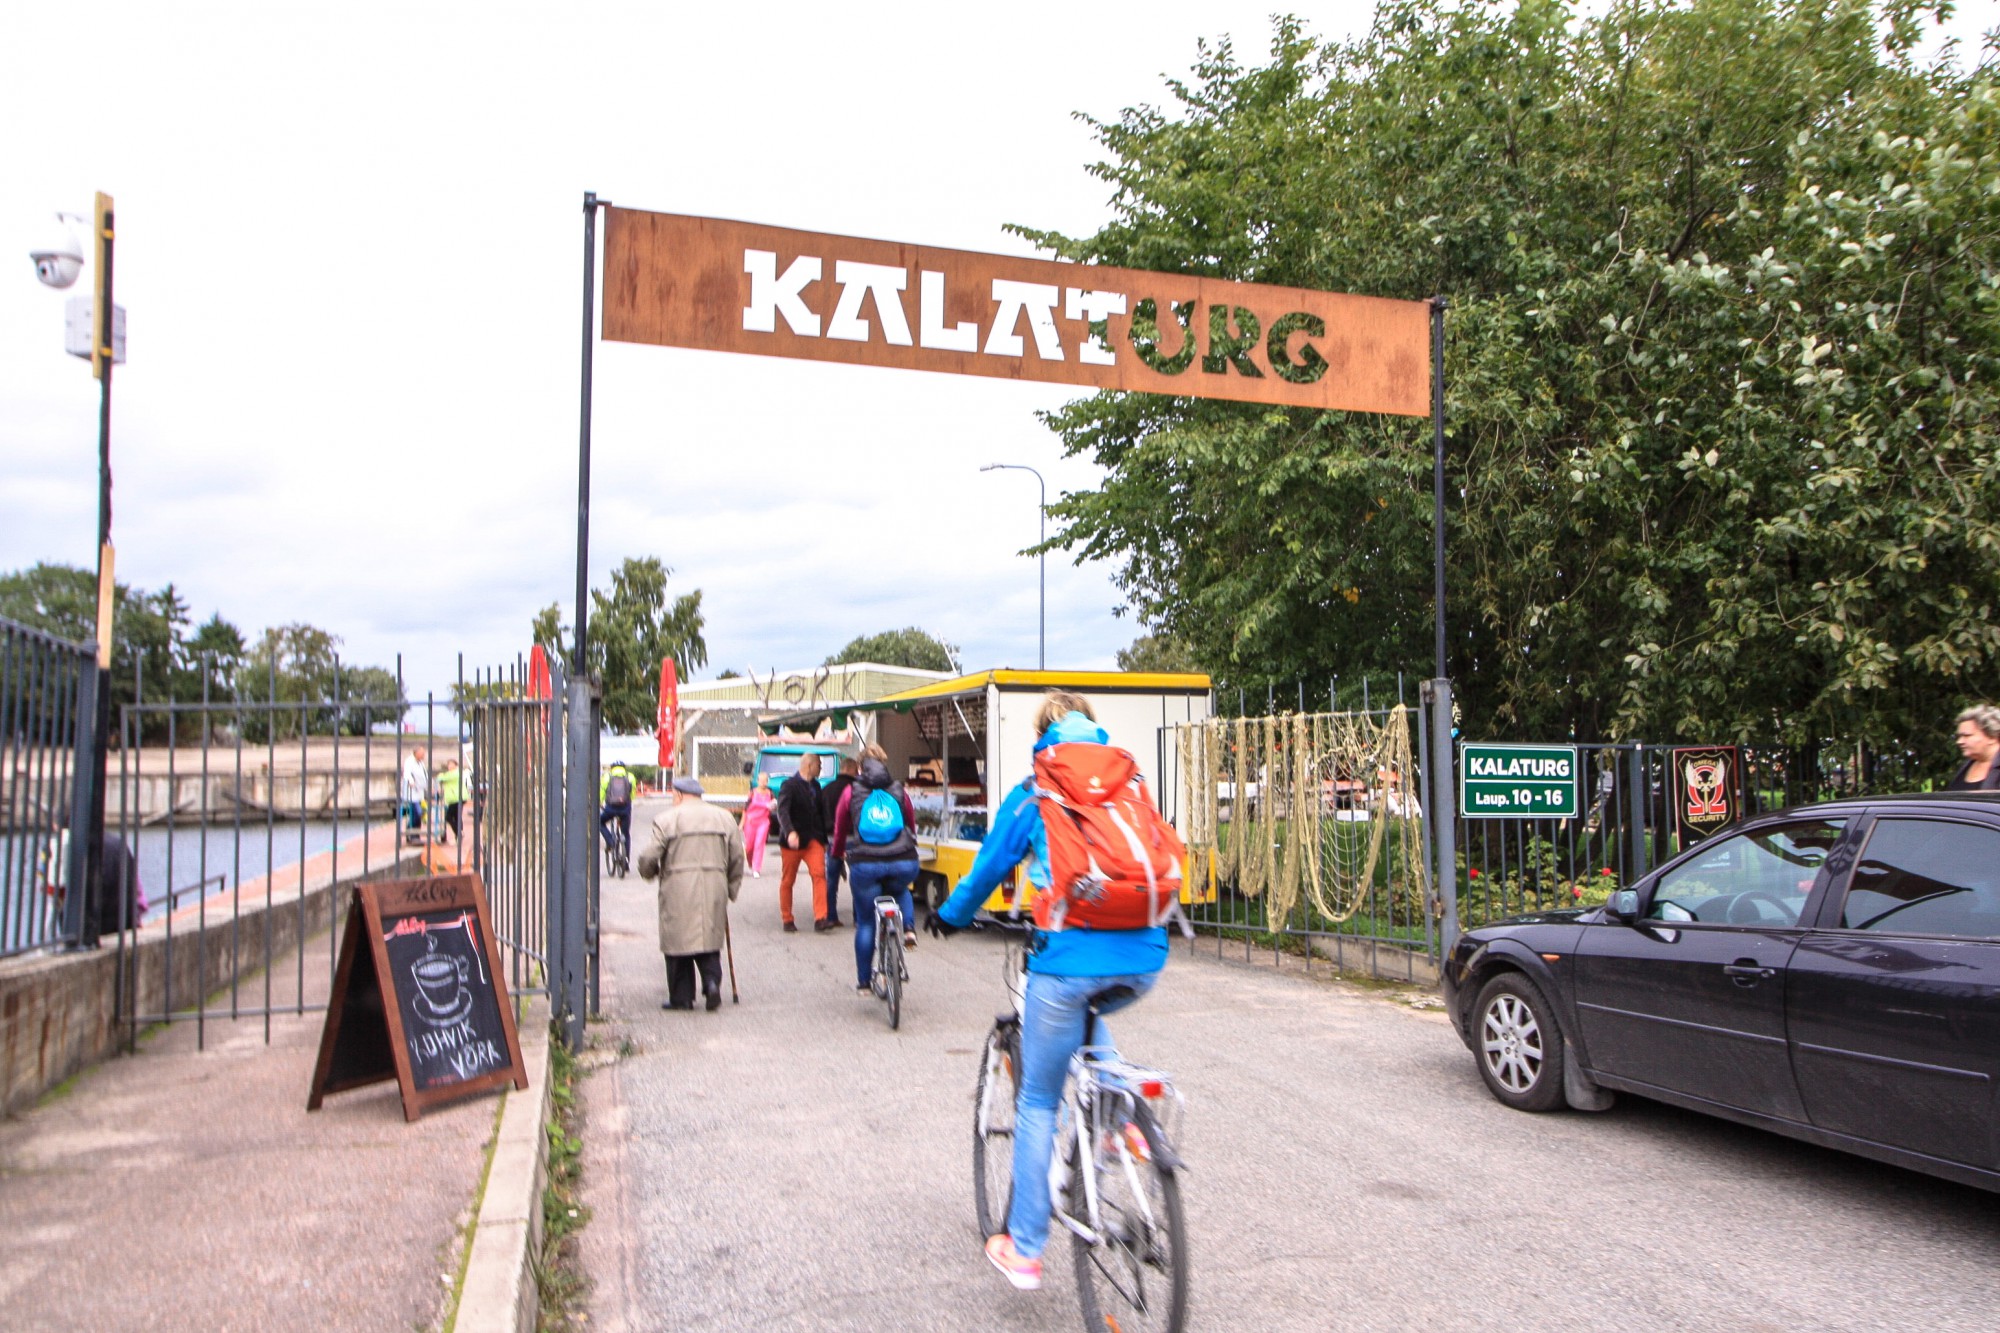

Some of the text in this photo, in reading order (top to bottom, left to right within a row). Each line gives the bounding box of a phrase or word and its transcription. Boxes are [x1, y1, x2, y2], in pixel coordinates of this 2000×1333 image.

[743, 248, 1330, 384] KALATURG
[1470, 757, 1570, 777] KALATURG
[1475, 792, 1509, 807] Laup.
[1512, 789, 1532, 806] 10
[1544, 789, 1563, 806] 16
[1688, 814, 1726, 823] SECURITY
[410, 1018, 477, 1065] KOHVIK
